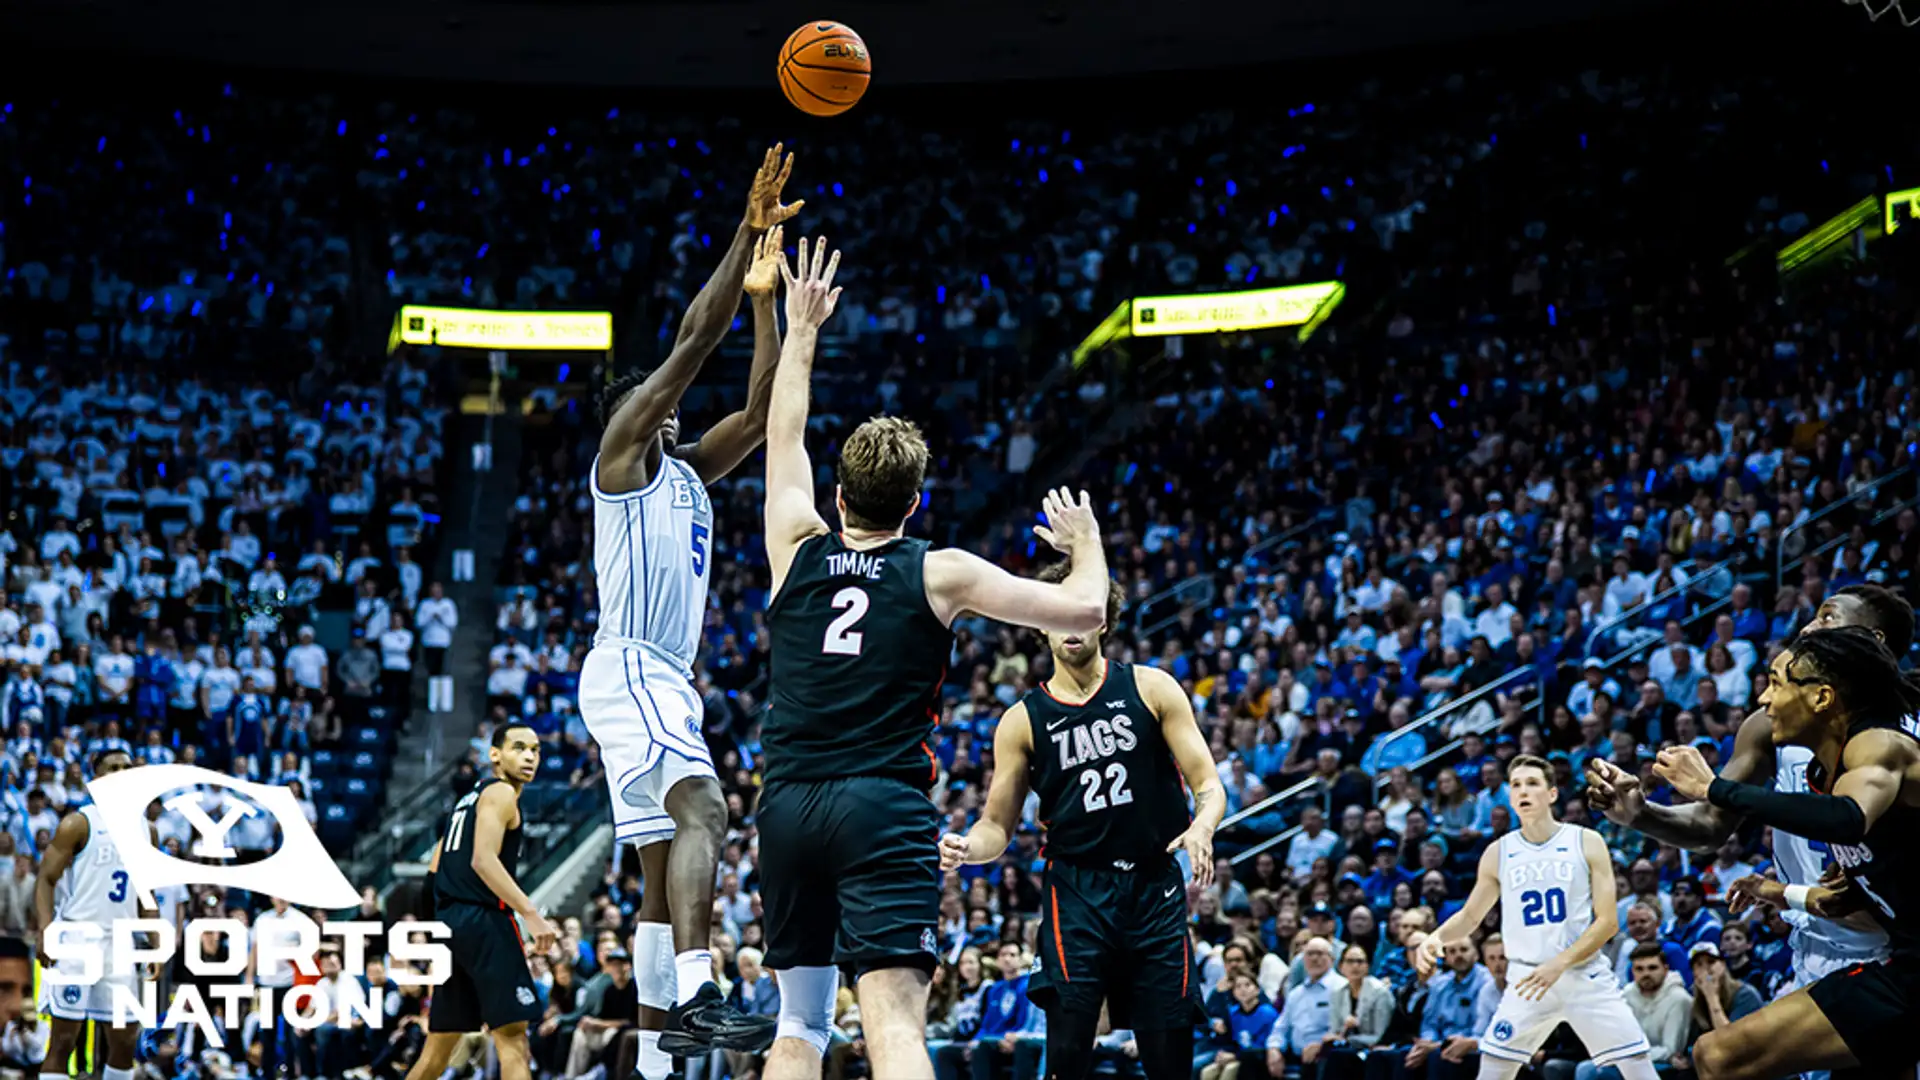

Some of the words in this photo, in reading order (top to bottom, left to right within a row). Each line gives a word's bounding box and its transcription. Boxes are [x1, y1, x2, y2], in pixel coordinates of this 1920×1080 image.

[691, 521, 709, 578] 5
[825, 551, 885, 580] TIMME
[822, 586, 870, 656] 2
[1051, 714, 1137, 770] ZAGS
[1080, 762, 1134, 812] 22
[445, 809, 467, 852] 11
[108, 869, 129, 904] 3
[1509, 860, 1576, 889] BYU
[1520, 887, 1567, 927] 20
